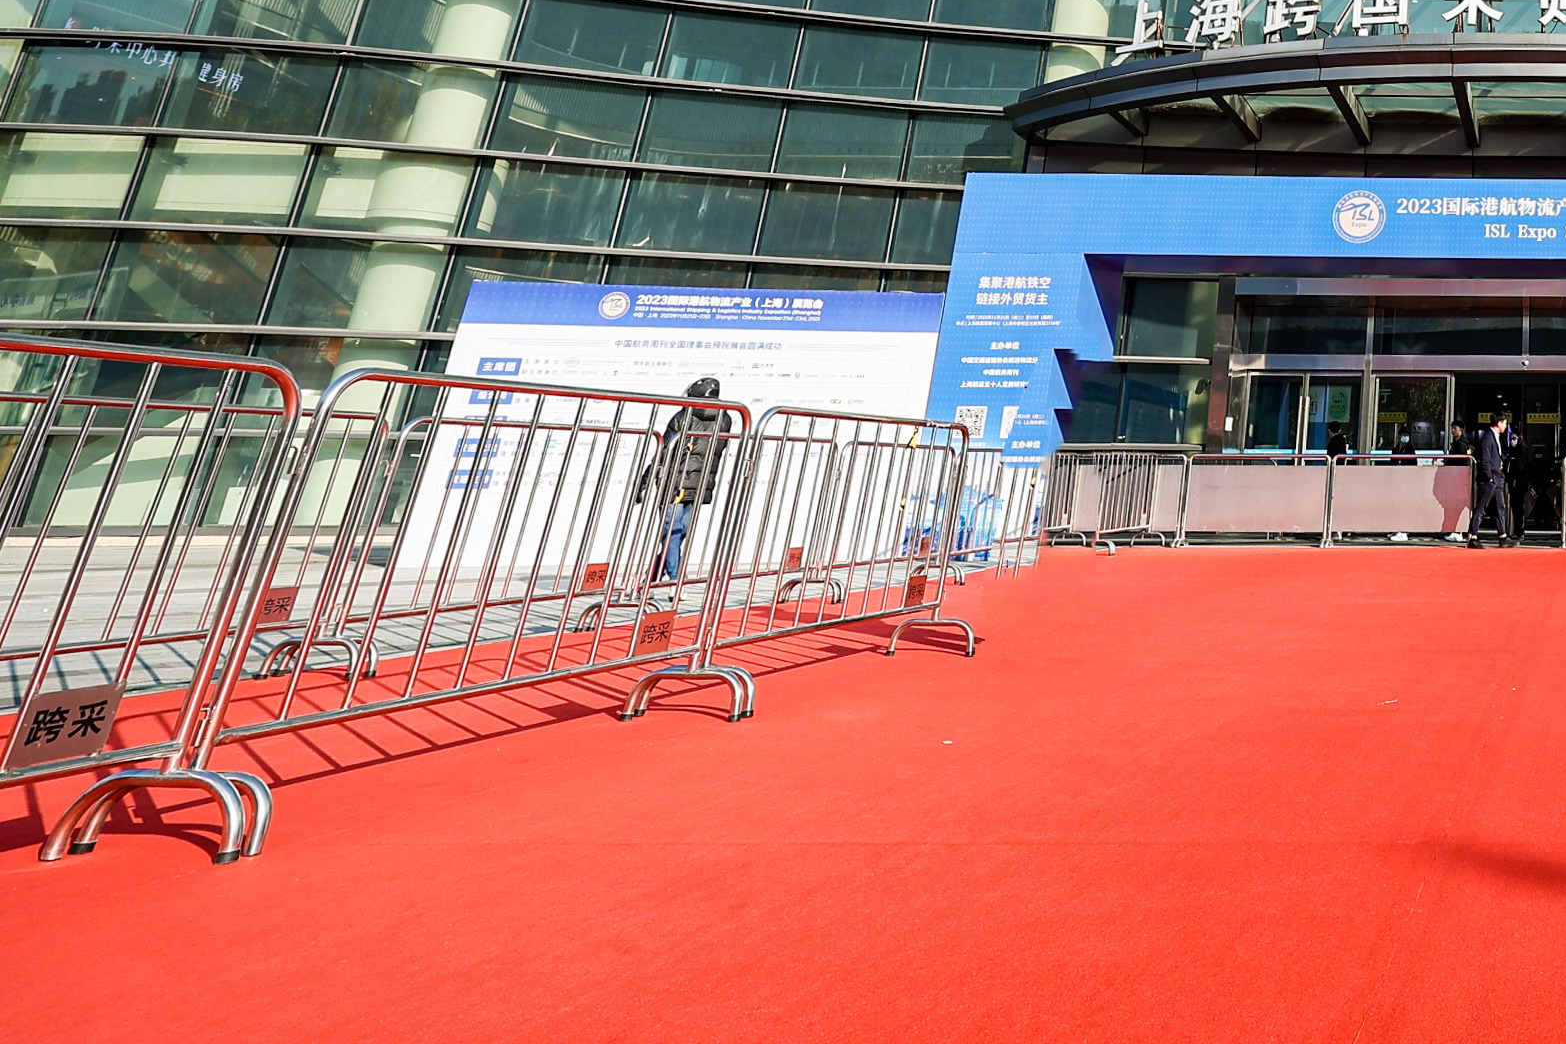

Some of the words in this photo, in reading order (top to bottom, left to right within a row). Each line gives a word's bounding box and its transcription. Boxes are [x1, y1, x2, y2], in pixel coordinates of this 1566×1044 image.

[1484, 224, 1510, 239] ISL
[1518, 224, 1557, 242] Expo
[978, 276, 1052, 289] 集聚港航铁空
[976, 292, 1049, 306] 链接外贸货主
[640, 621, 671, 645] 跨采
[24, 699, 109, 747] 跨采
